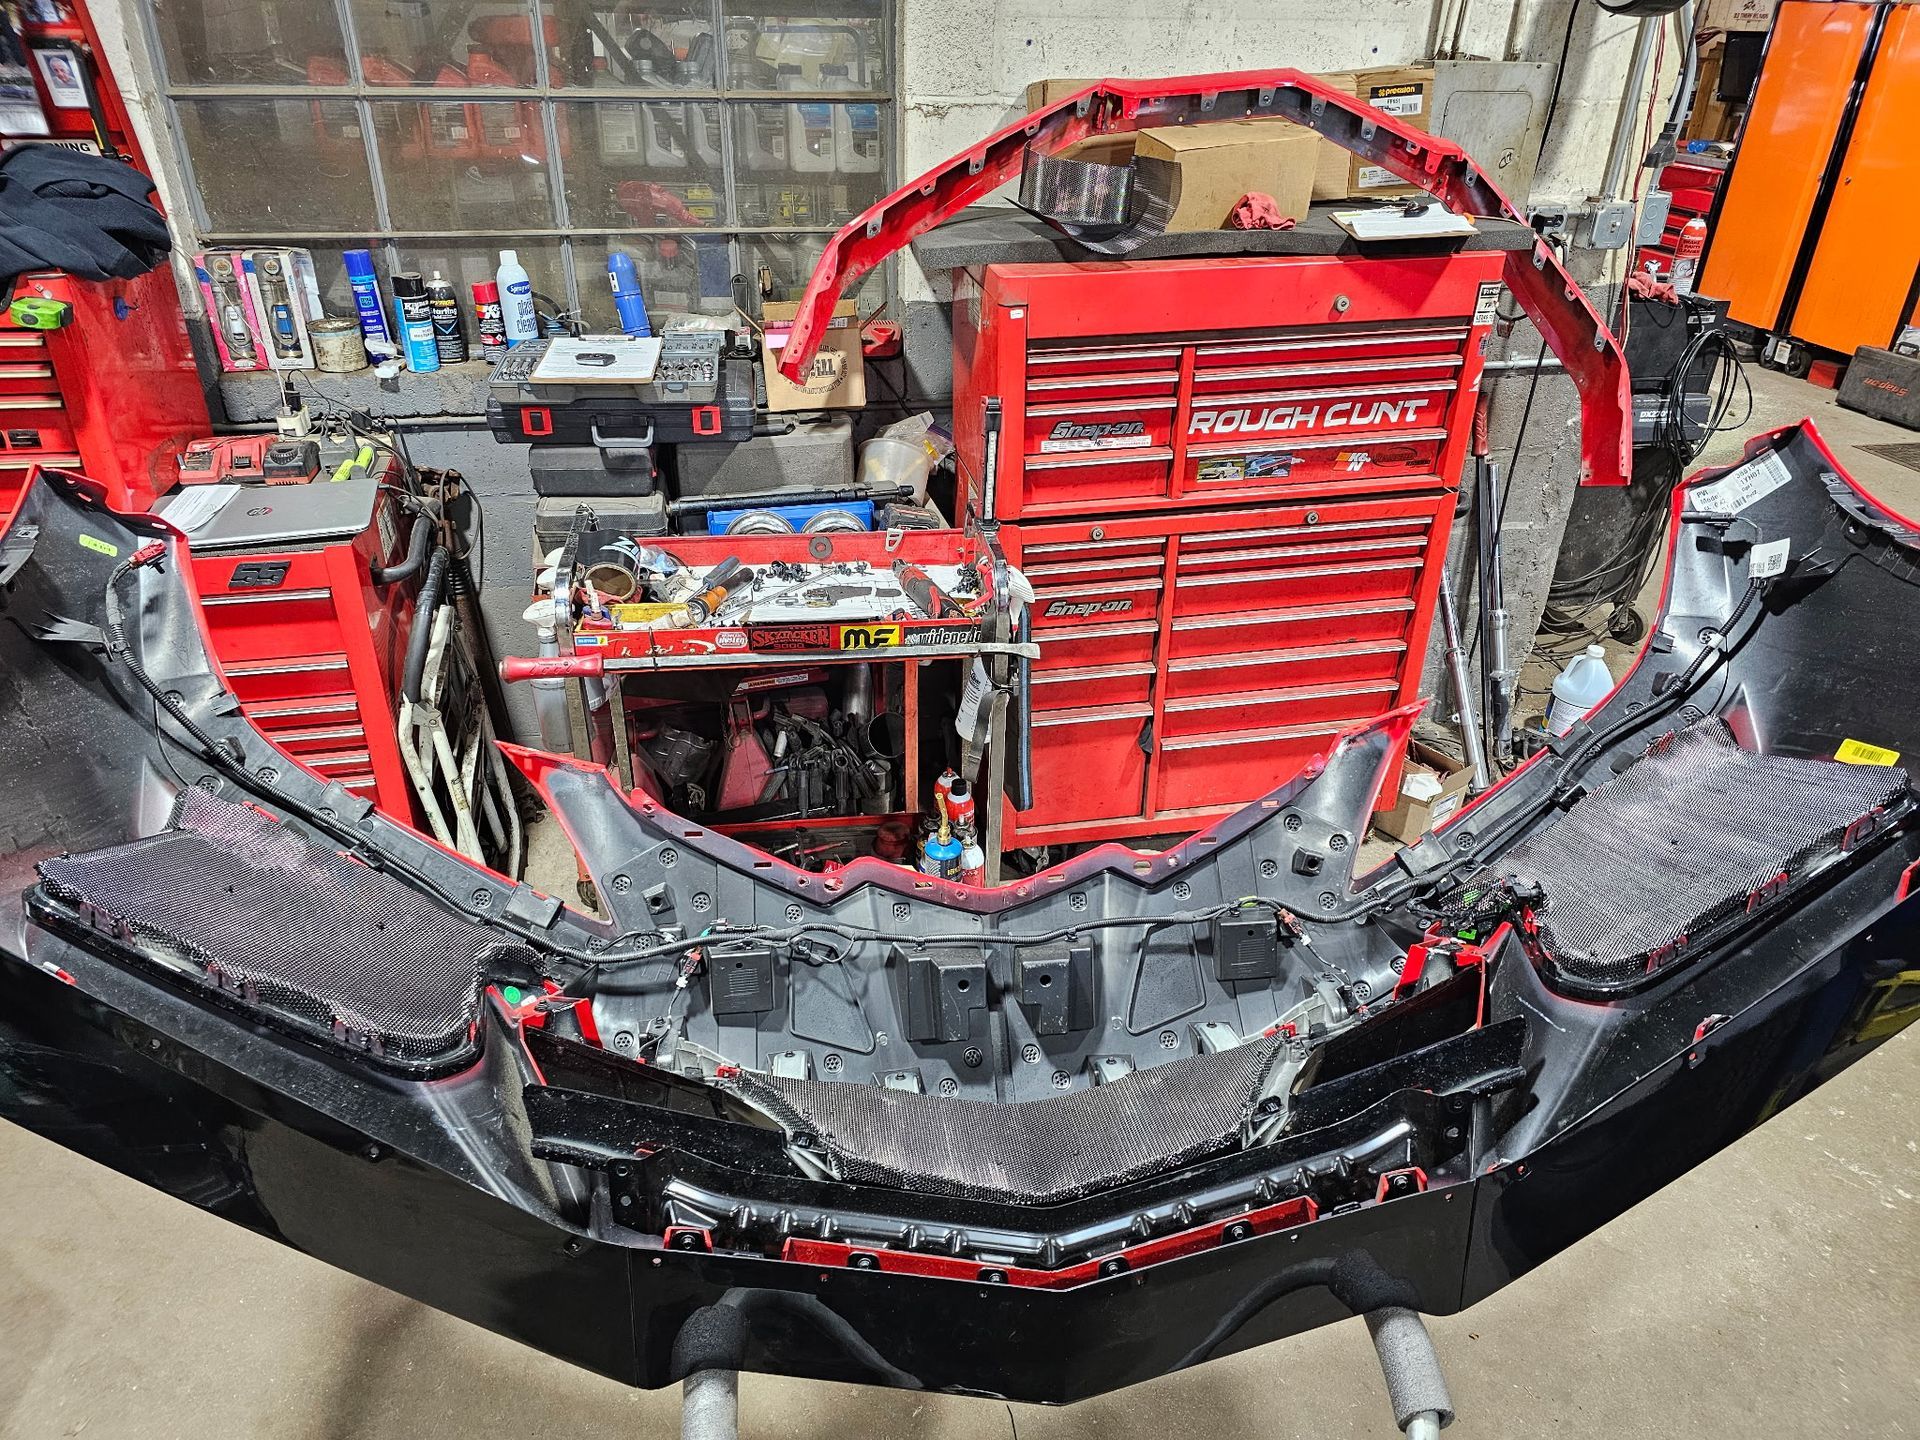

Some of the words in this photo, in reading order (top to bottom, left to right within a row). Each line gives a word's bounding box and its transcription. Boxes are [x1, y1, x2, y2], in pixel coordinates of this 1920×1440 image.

[1188, 405, 1321, 435] ROUGH
[1323, 398, 1430, 428] CUNT
[1049, 420, 1144, 440] Snap-on
[1044, 600, 1133, 617] Snap-on
[752, 628, 830, 648] SKYJACKER
